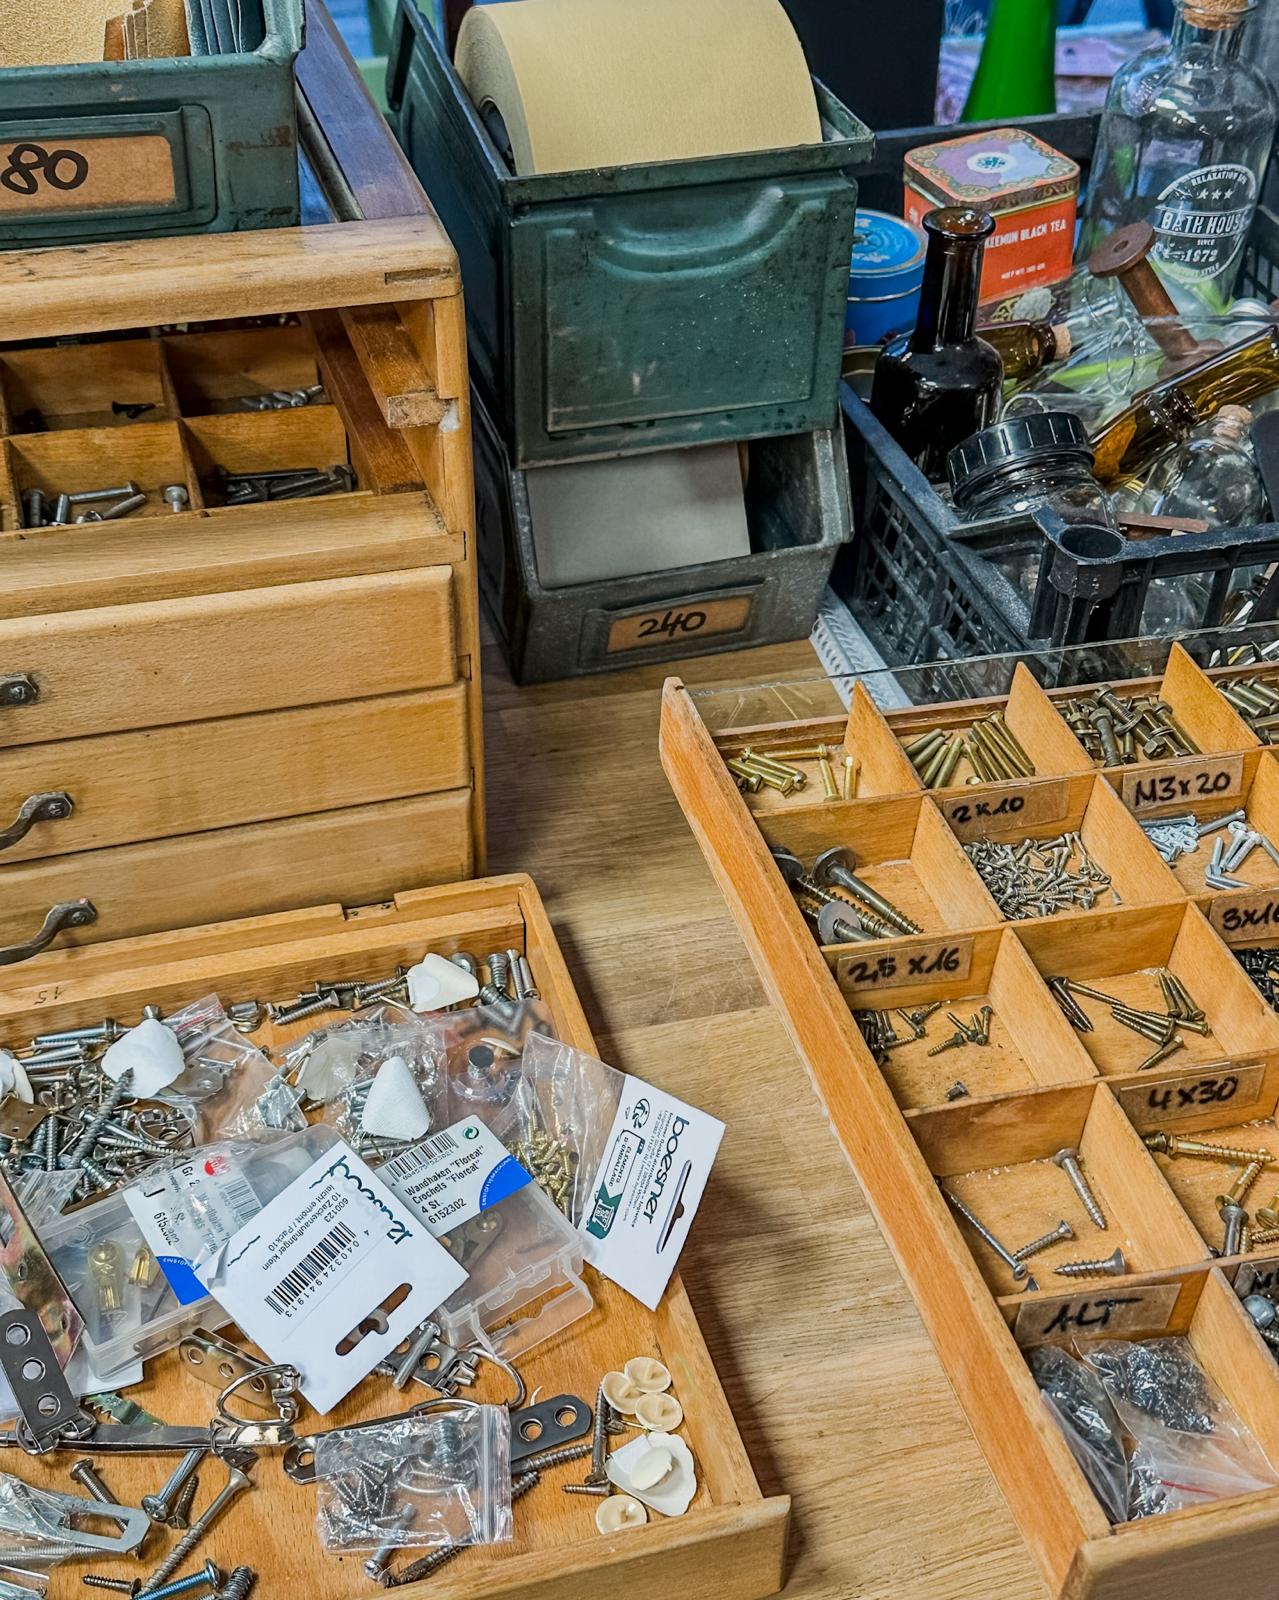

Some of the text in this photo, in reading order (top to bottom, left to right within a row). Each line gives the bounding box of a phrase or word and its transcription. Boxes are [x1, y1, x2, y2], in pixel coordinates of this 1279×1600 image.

[1050, 218, 1067, 233] TEA
[1161, 211, 1204, 234] BATH
[637, 611, 707, 638] 240
[404, 1167, 451, 1195] Wandhaken
[643, 1116, 690, 1225] boesner
[331, 1192, 341, 1202] 10
[412, 1182, 447, 1204] Crochets
[323, 1197, 348, 1222] 600123
[421, 1205, 429, 1213] 4
[428, 1198, 466, 1224] 6152302
